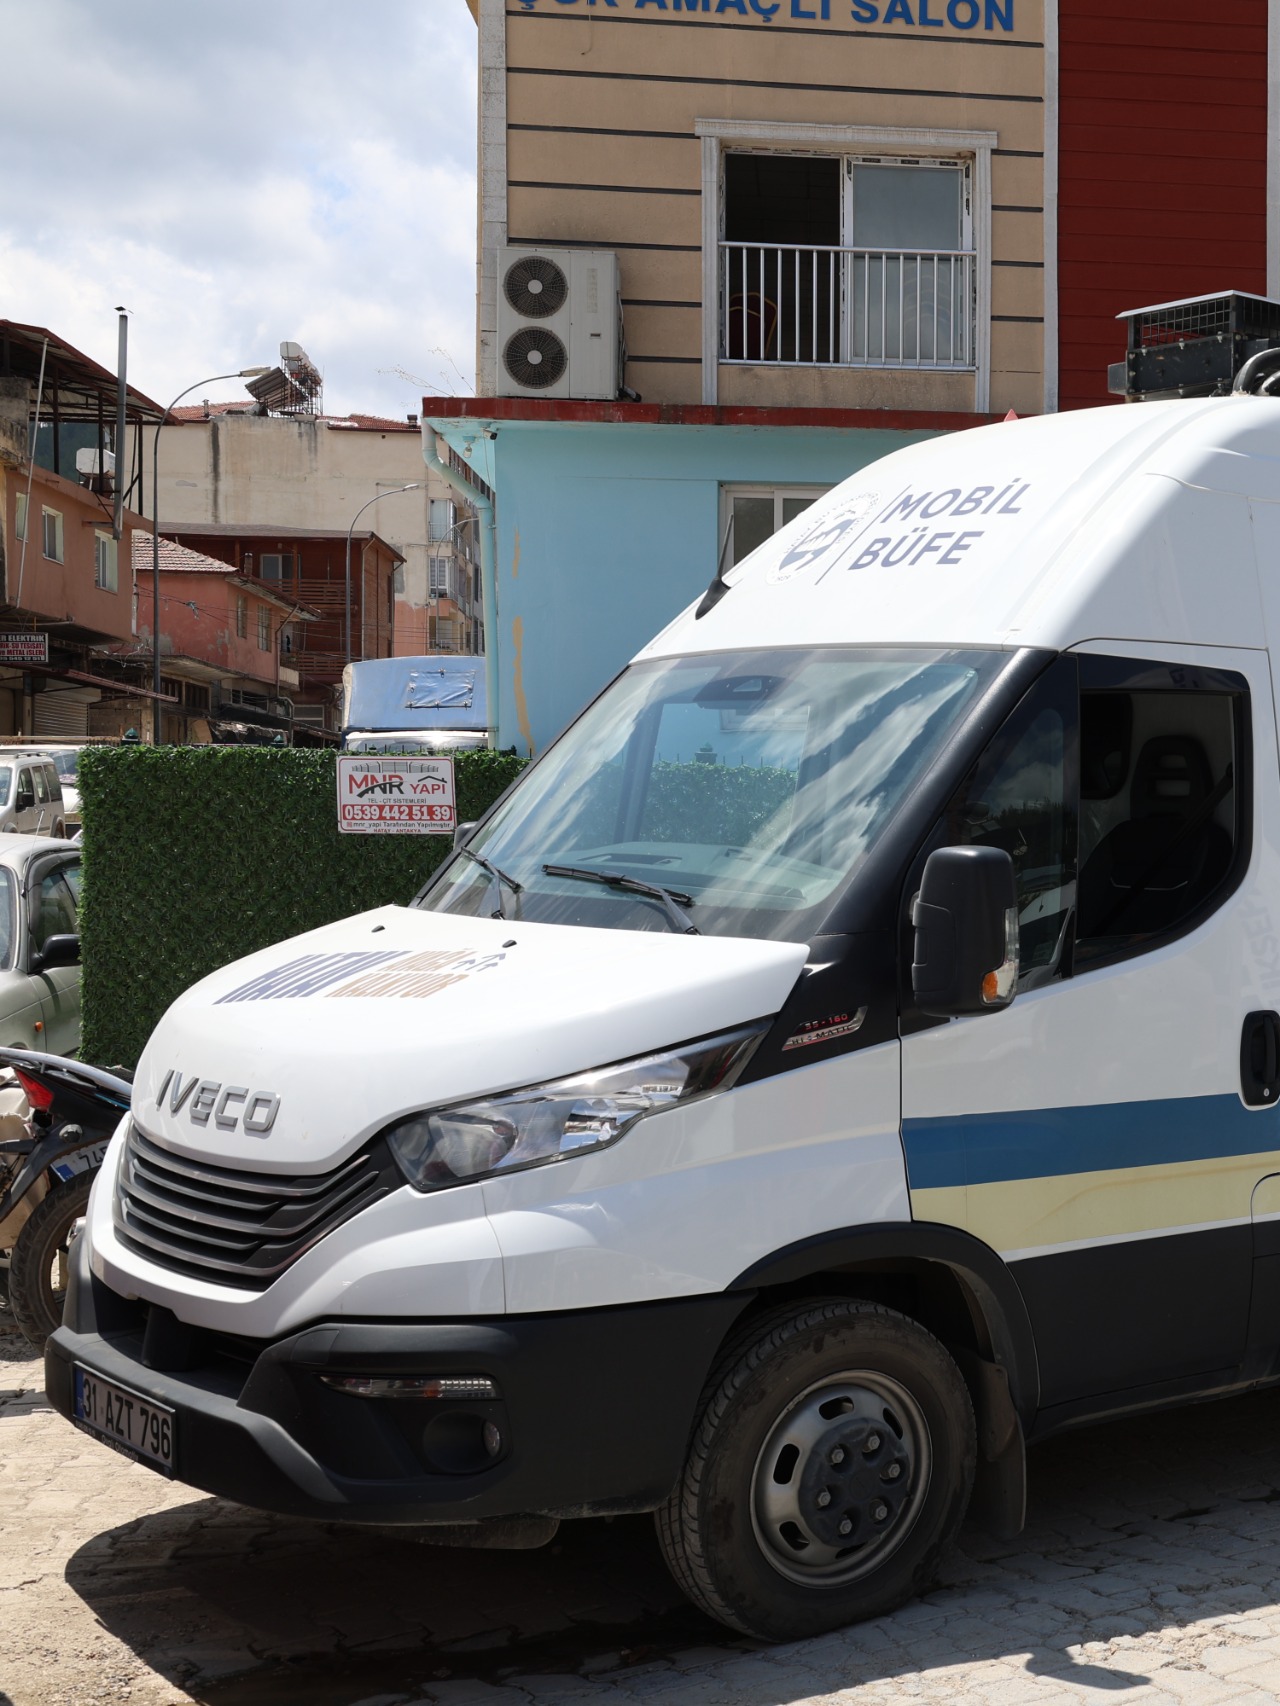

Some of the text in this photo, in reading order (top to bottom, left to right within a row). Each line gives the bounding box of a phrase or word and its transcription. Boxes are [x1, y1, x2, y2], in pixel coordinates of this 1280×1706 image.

[850, 0, 1014, 31] SALON
[880, 478, 1031, 524] MOBİL
[848, 526, 984, 571] BÜFE
[349, 774, 446, 796] MNR YAPI
[345, 805, 451, 819] 0539 442 51 39
[155, 1069, 281, 1133] IVECO
[83, 1378, 96, 1422] 31
[106, 1391, 133, 1440] AZT
[140, 1406, 170, 1460] 796
